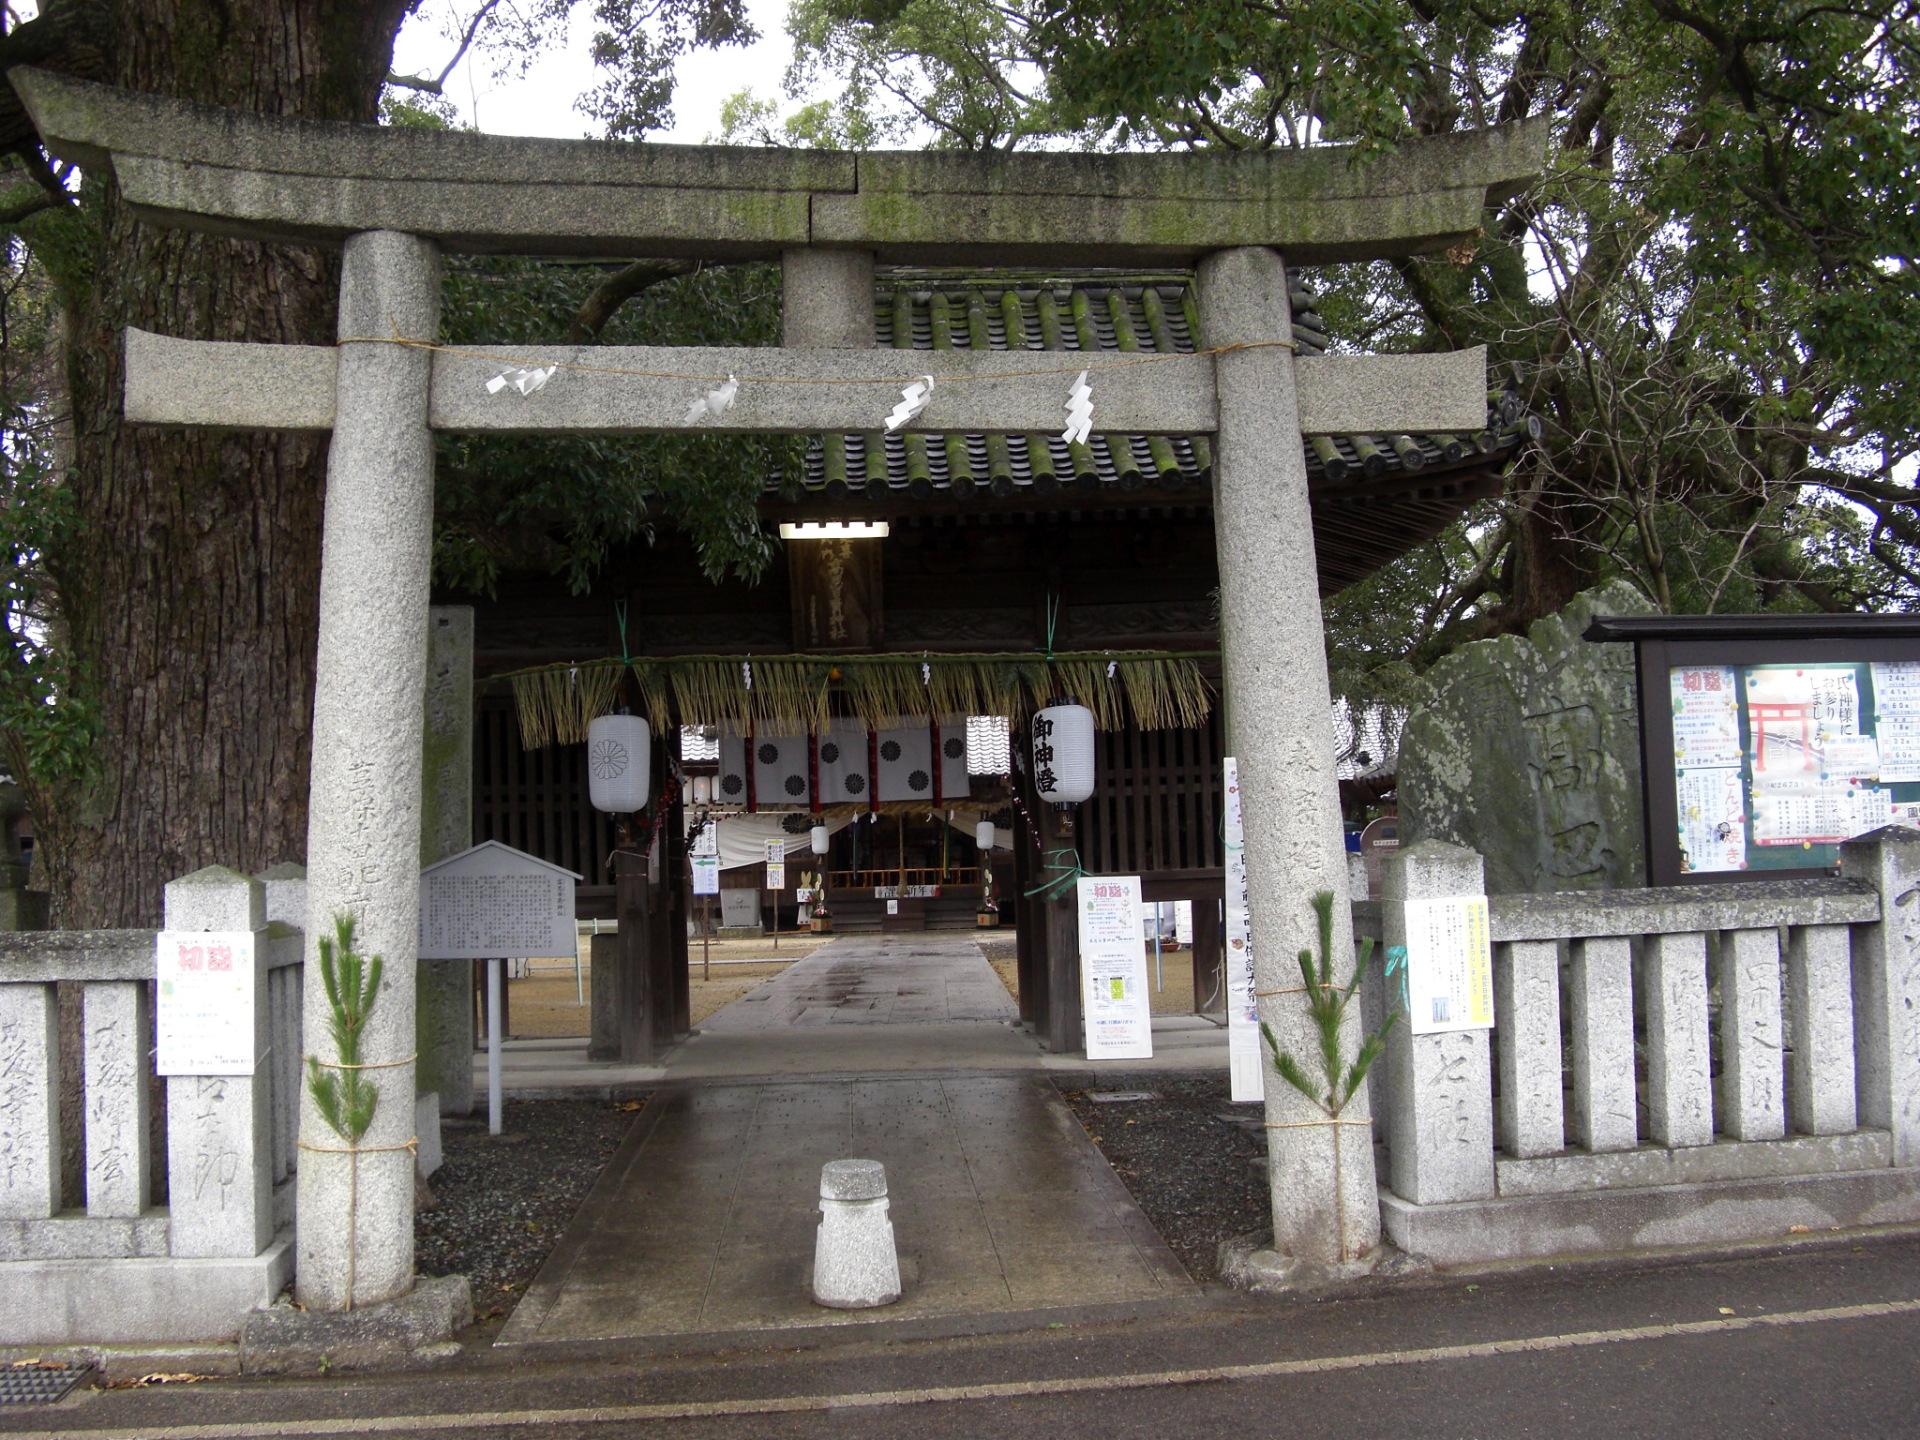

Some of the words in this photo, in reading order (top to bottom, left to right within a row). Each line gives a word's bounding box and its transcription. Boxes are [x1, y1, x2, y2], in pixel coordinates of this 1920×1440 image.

[1810, 675, 1825, 748] しましょう
[1823, 677, 1838, 721] お参り
[1837, 675, 1853, 736] 氏神様に
[1033, 713, 1058, 794] 御神燈
[1724, 770, 1742, 865] どんど焼き
[178, 944, 233, 972] 初詣
